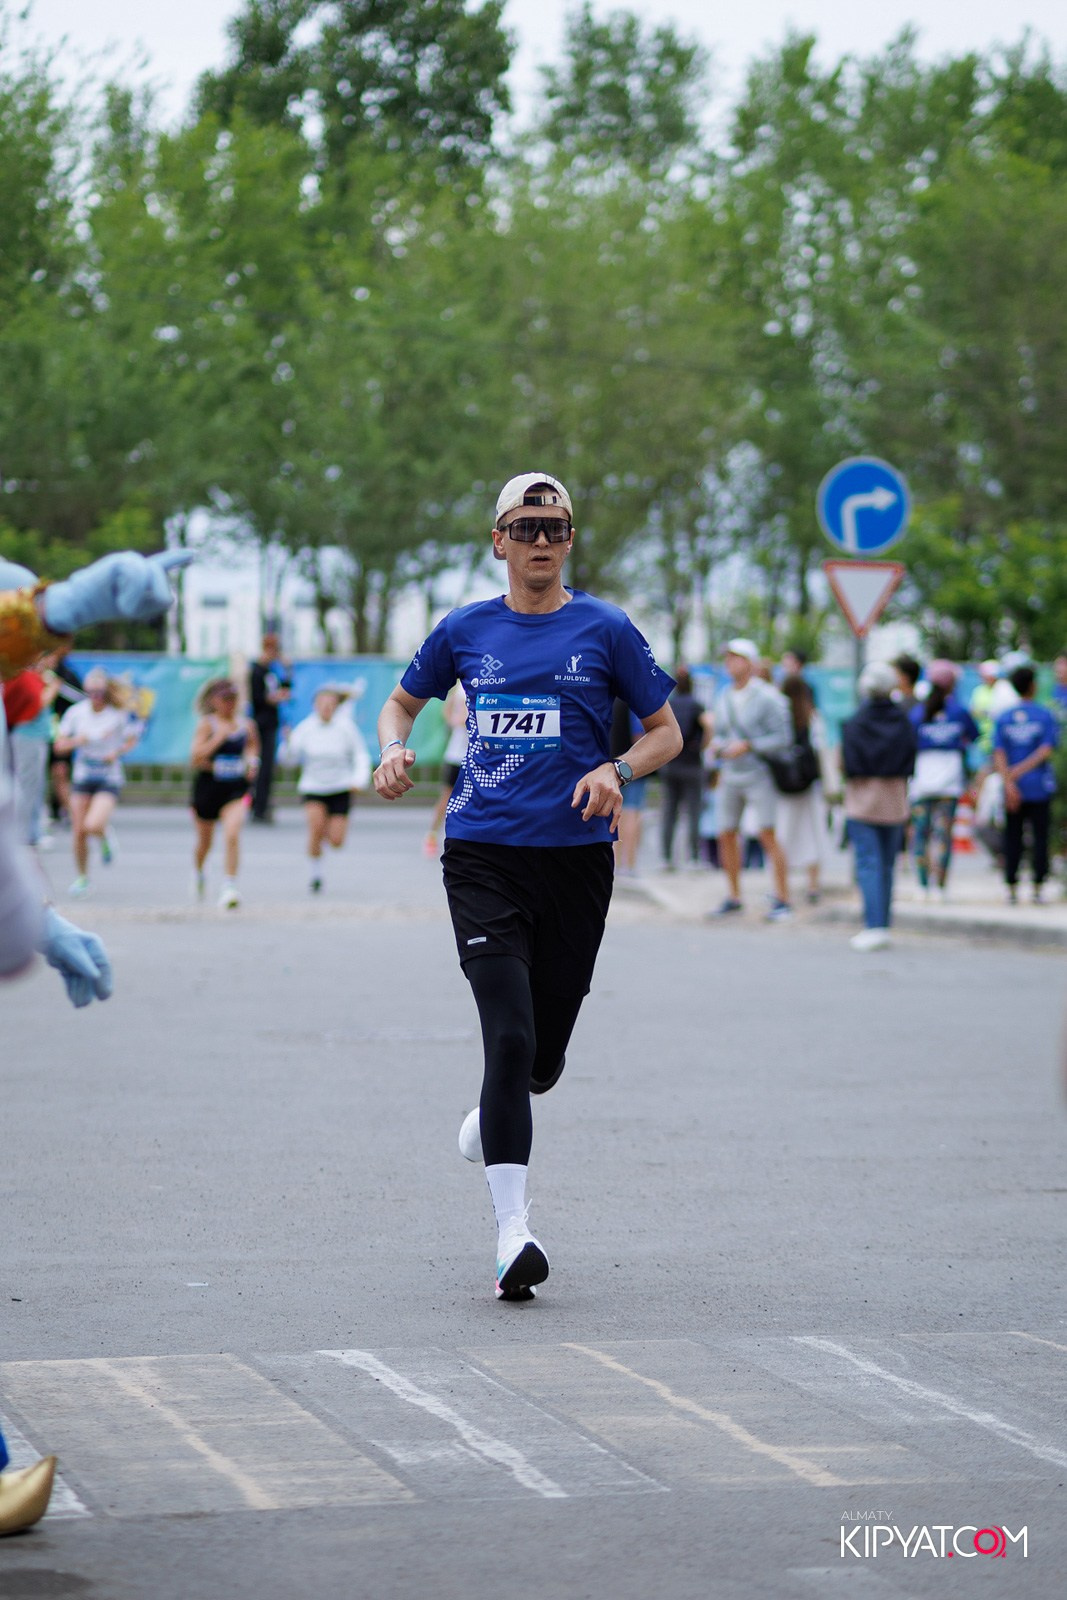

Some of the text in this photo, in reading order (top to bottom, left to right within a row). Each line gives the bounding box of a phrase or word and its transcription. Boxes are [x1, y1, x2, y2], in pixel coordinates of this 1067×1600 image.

[479, 677, 506, 686] GROUP
[479, 696, 485, 704] 5
[490, 712, 546, 734] 1741
